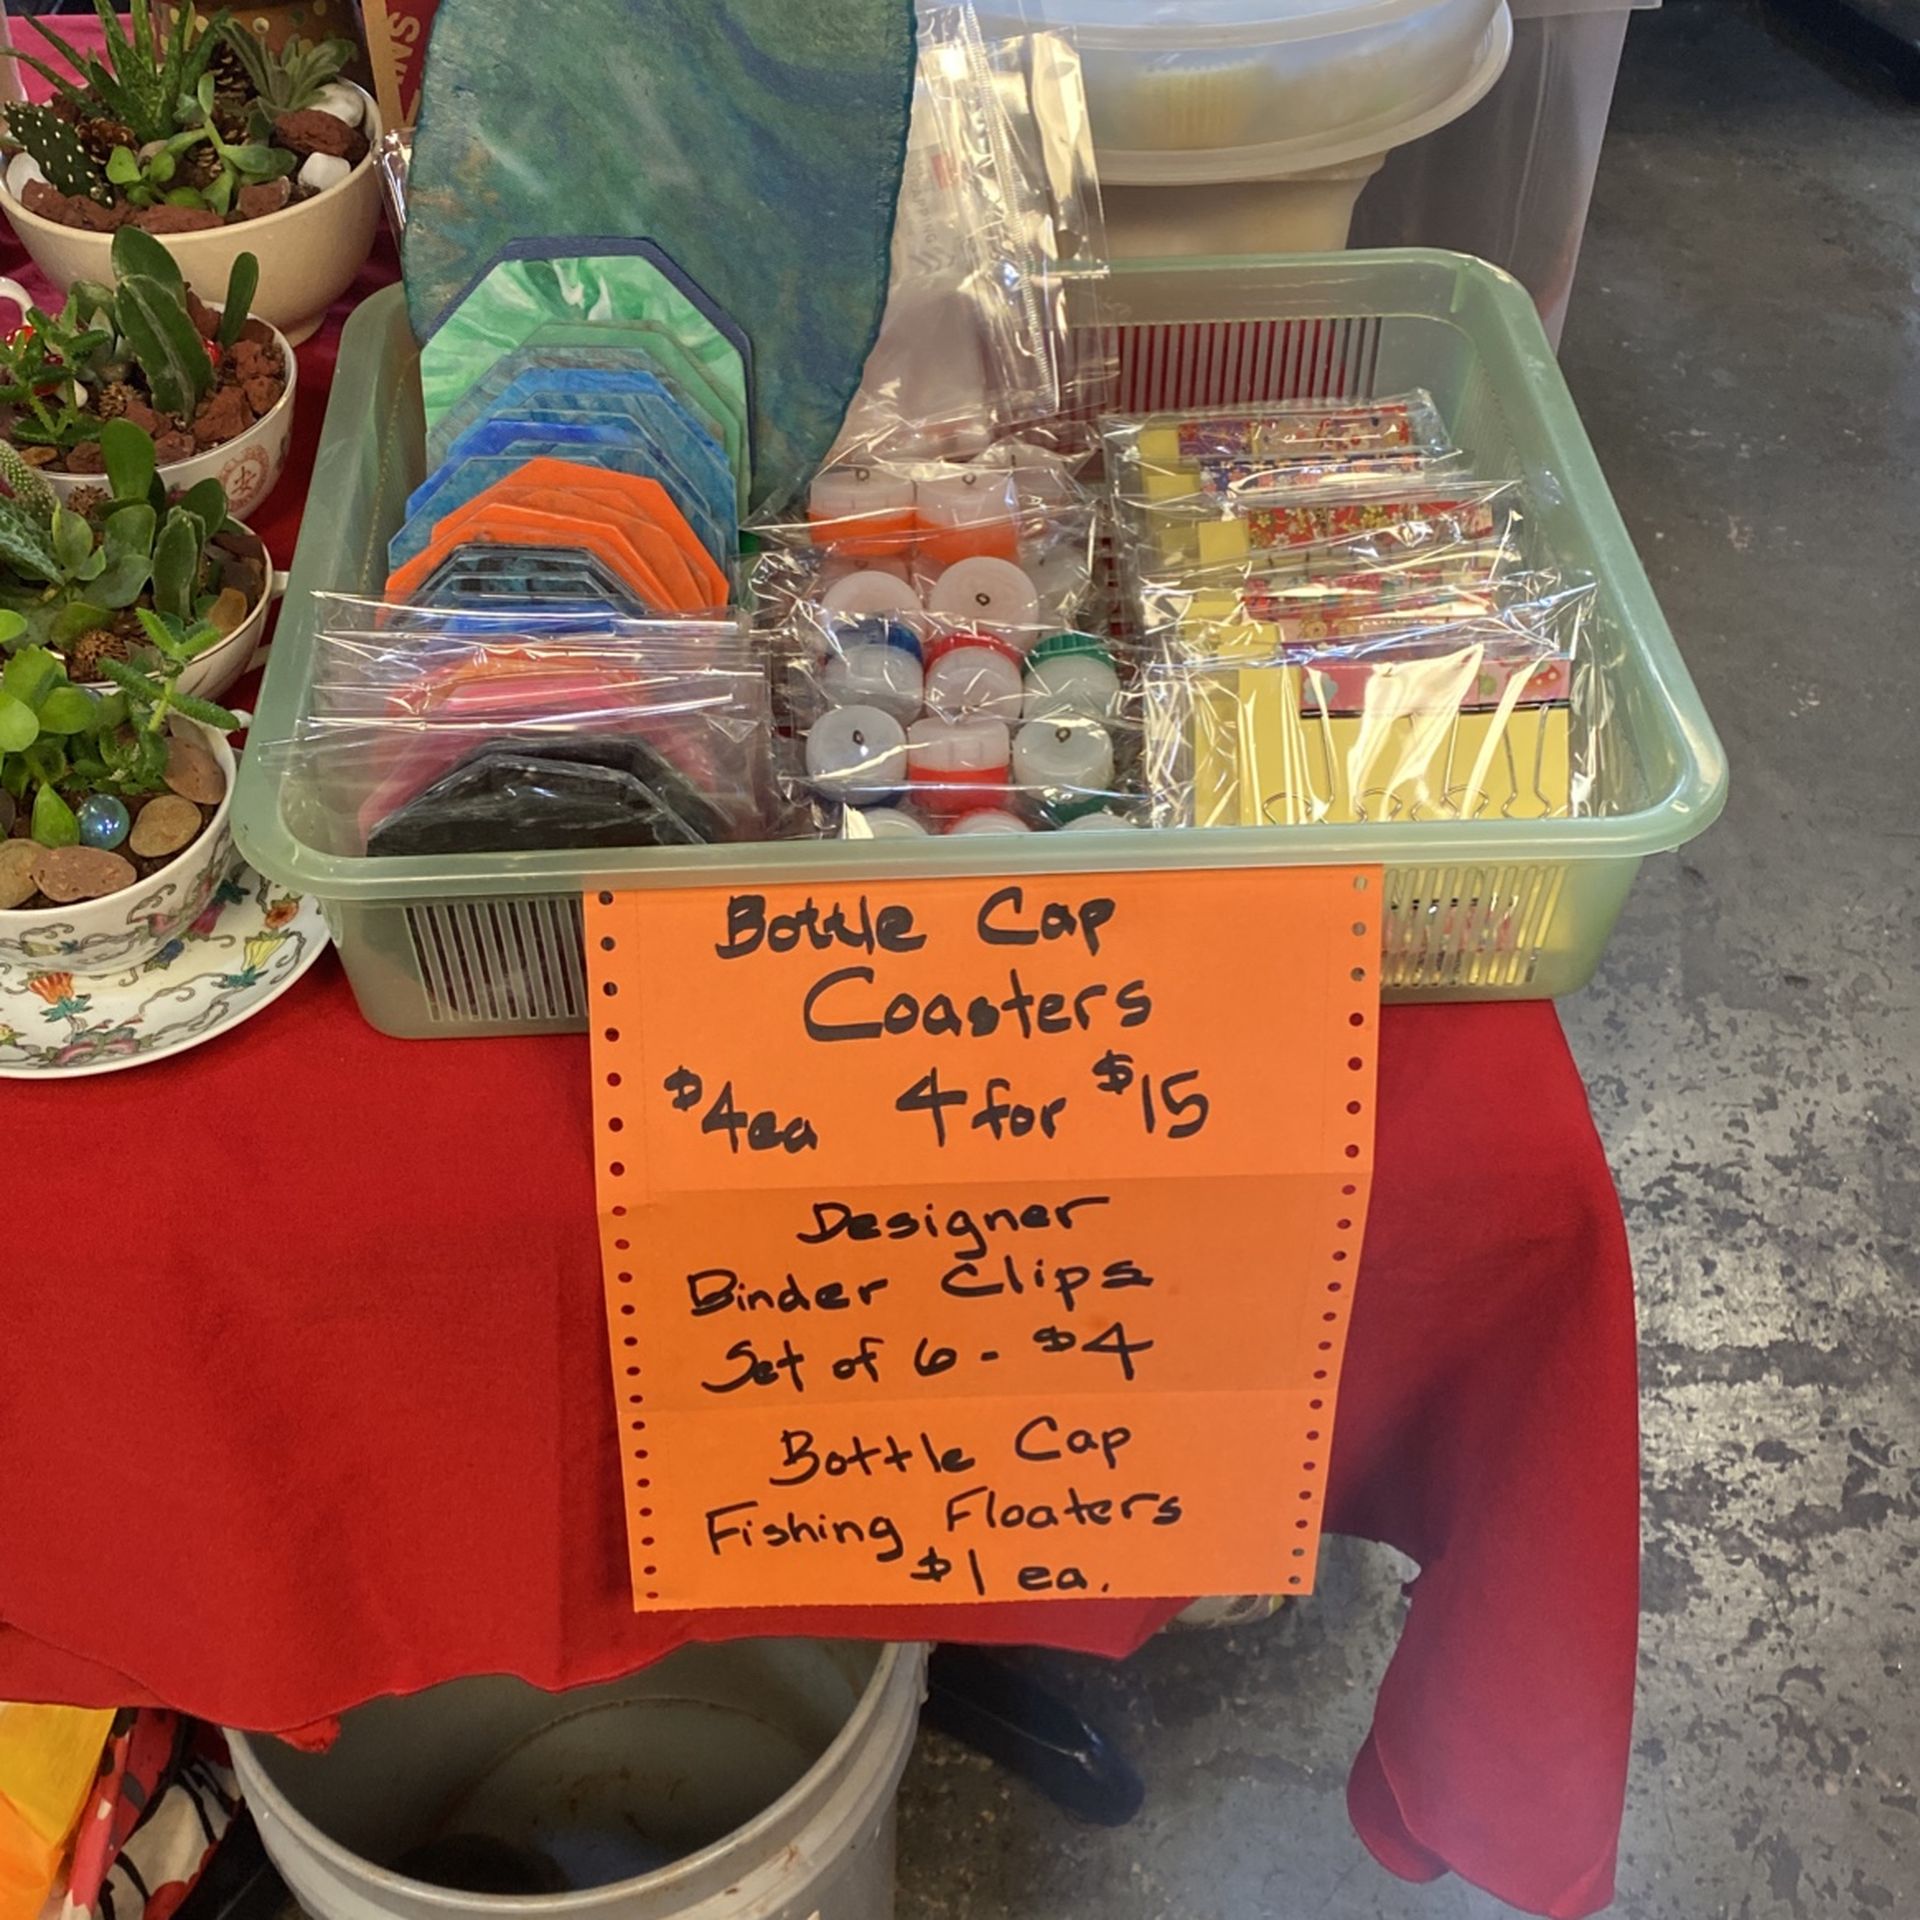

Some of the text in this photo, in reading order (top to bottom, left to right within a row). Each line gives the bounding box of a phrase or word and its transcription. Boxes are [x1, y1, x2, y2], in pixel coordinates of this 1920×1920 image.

[714, 885, 1117, 961] Bottle Cap
[802, 965, 1153, 1043] Coasters
[894, 1066, 969, 1148] 4
[970, 1076, 1068, 1141] for
[1091, 1048, 1210, 1140] $15
[795, 1195, 1111, 1263] Designer
[685, 1253, 1155, 1318] Binder Clips
[700, 1338, 806, 1395] Set
[830, 1335, 885, 1384] of
[1031, 1320, 1155, 1382] $4
[768, 1414, 1132, 1487] Bottle Cap
[704, 1485, 1183, 1564] Fishing Floaters
[909, 1545, 1112, 1597] $1 ea.
